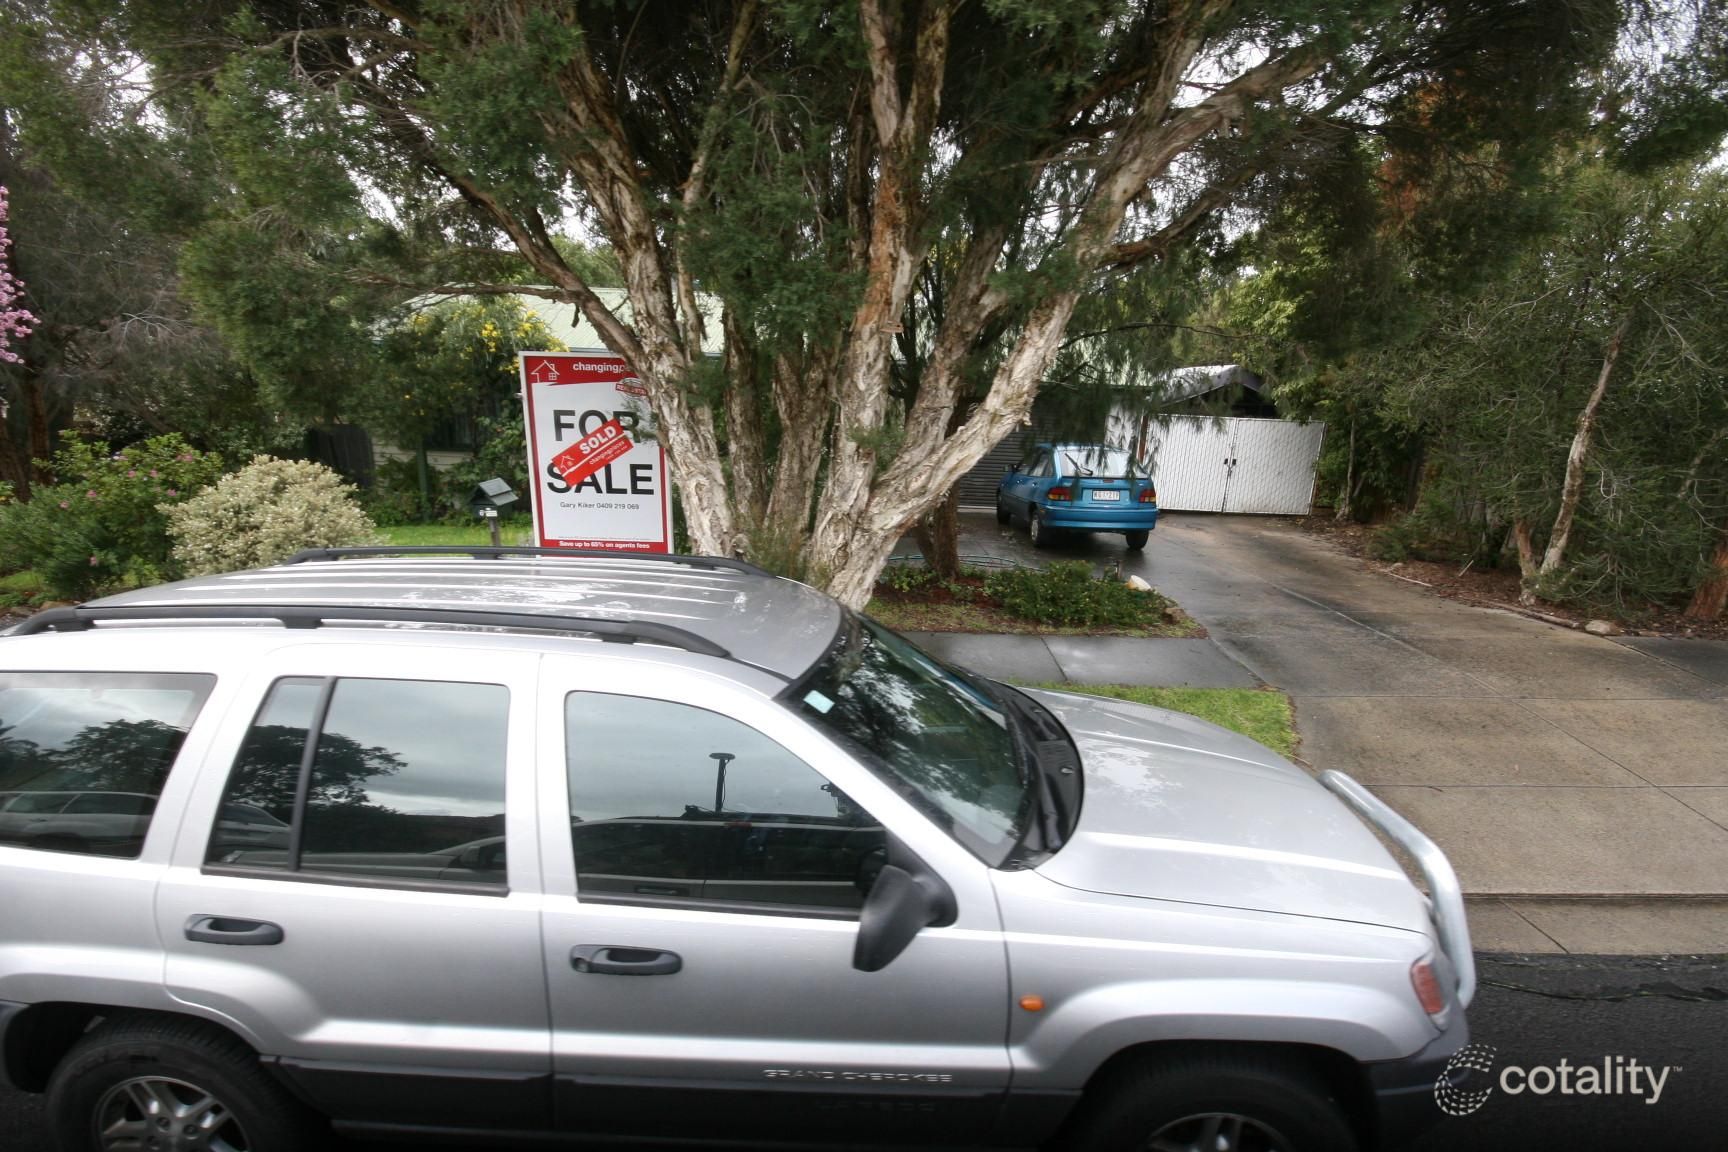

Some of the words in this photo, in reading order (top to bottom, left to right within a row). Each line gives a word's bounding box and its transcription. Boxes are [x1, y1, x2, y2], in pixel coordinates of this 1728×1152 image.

[553, 409, 641, 444] FOR
[579, 425, 617, 455] SOLD
[546, 463, 655, 495] SALE
[763, 1069, 835, 1080] GRAND
[841, 1071, 953, 1083] CHEROKEE
